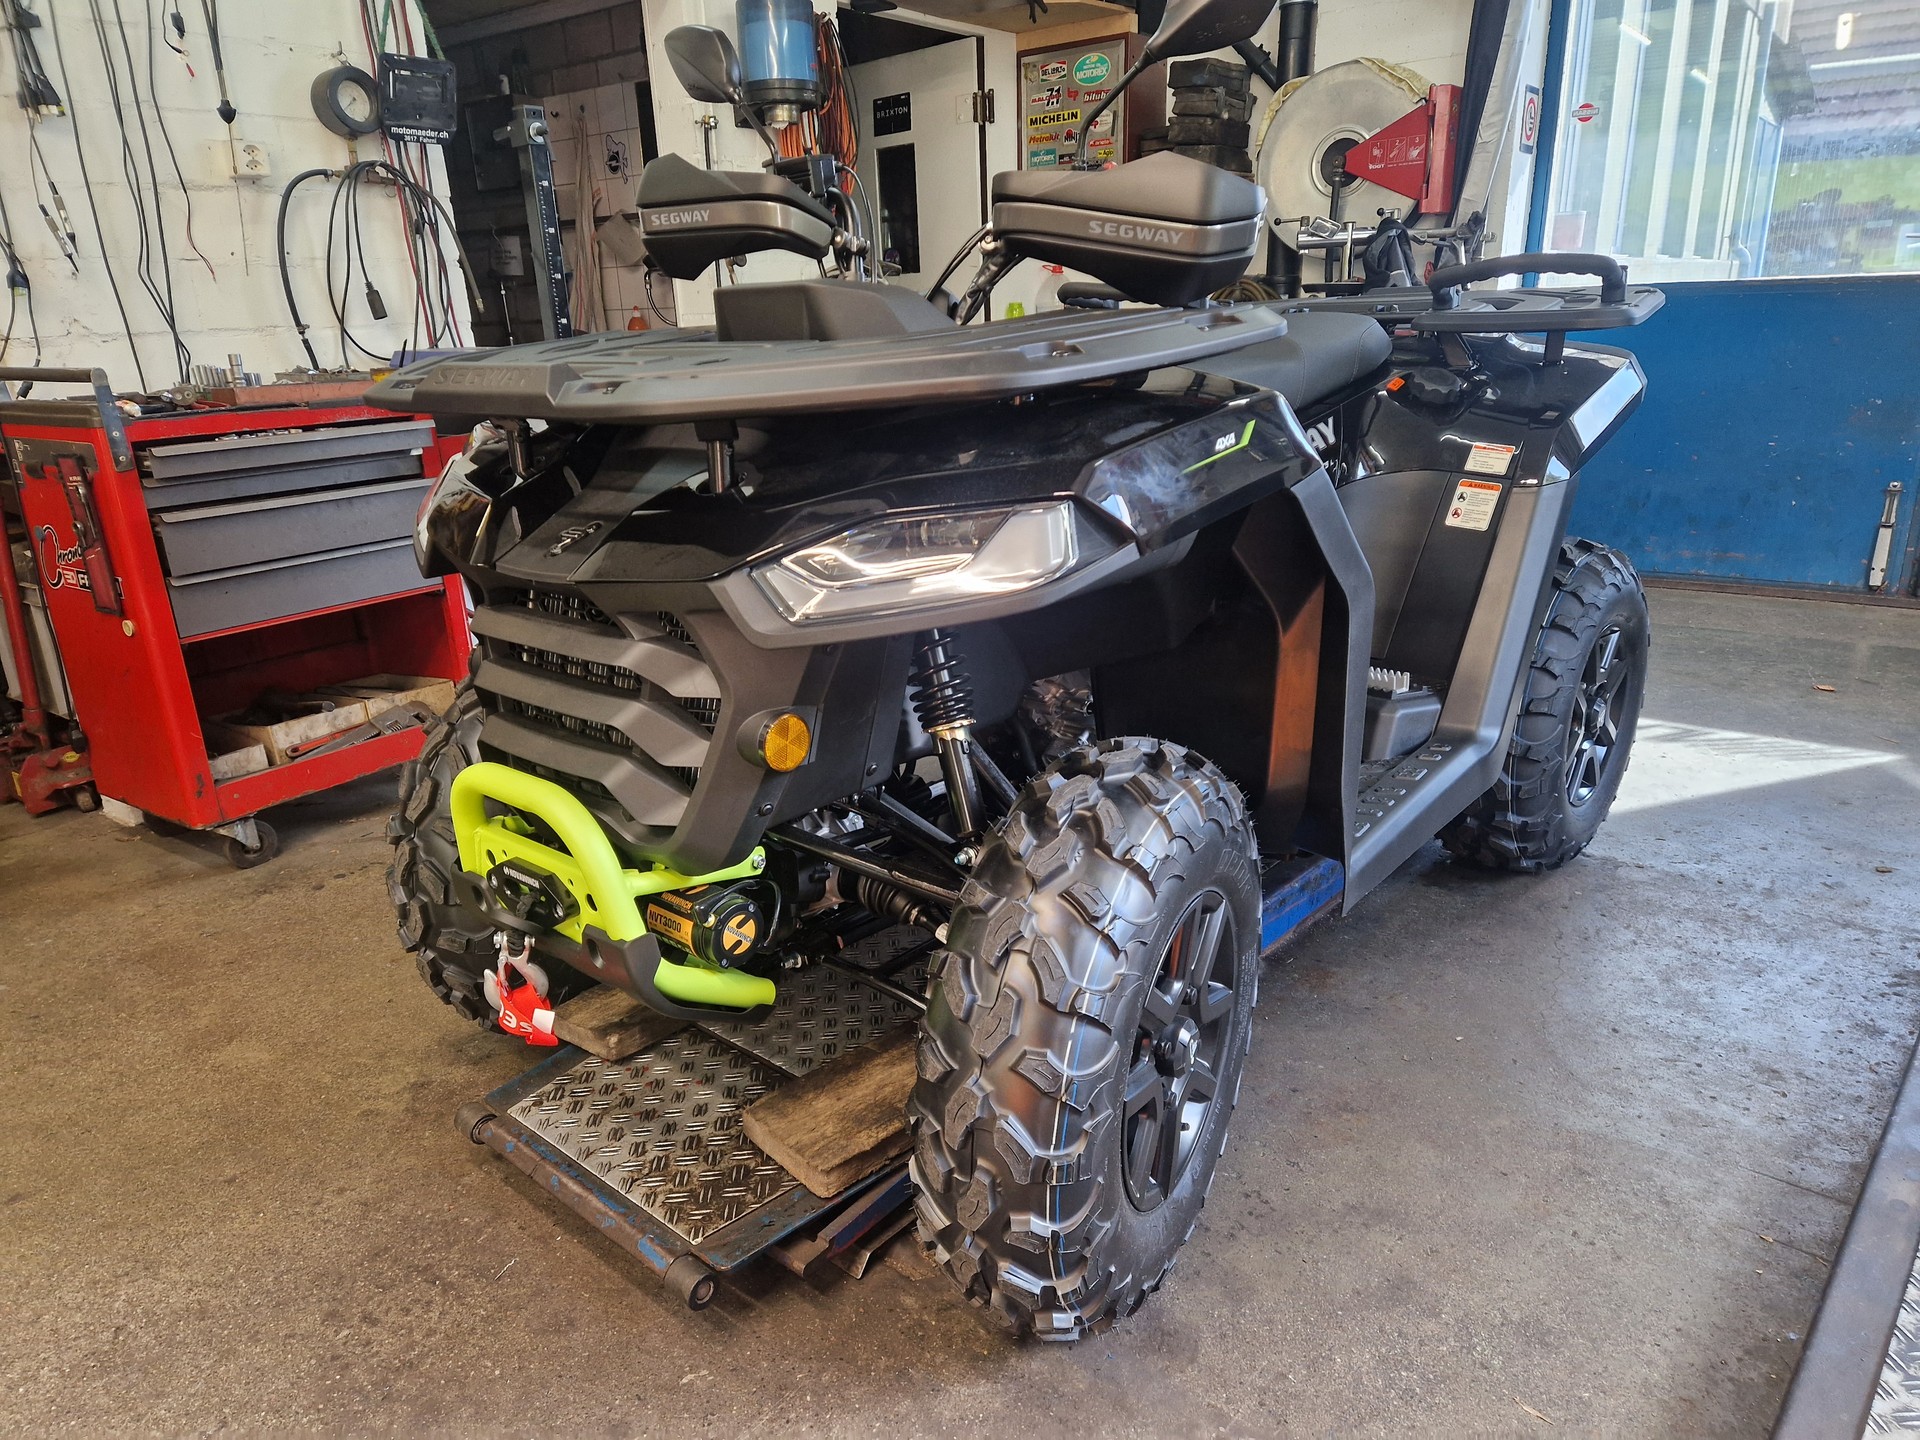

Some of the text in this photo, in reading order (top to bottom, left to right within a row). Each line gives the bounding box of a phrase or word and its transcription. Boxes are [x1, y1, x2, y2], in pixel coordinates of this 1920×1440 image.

[877, 106, 908, 118] BRIXTON
[1029, 110, 1078, 127] MICHELIN
[391, 126, 449, 139] motomaeder.ch
[651, 209, 710, 226] SEGWAY
[1088, 220, 1184, 245] SEGWAY
[649, 909, 682, 933] NVT3000
